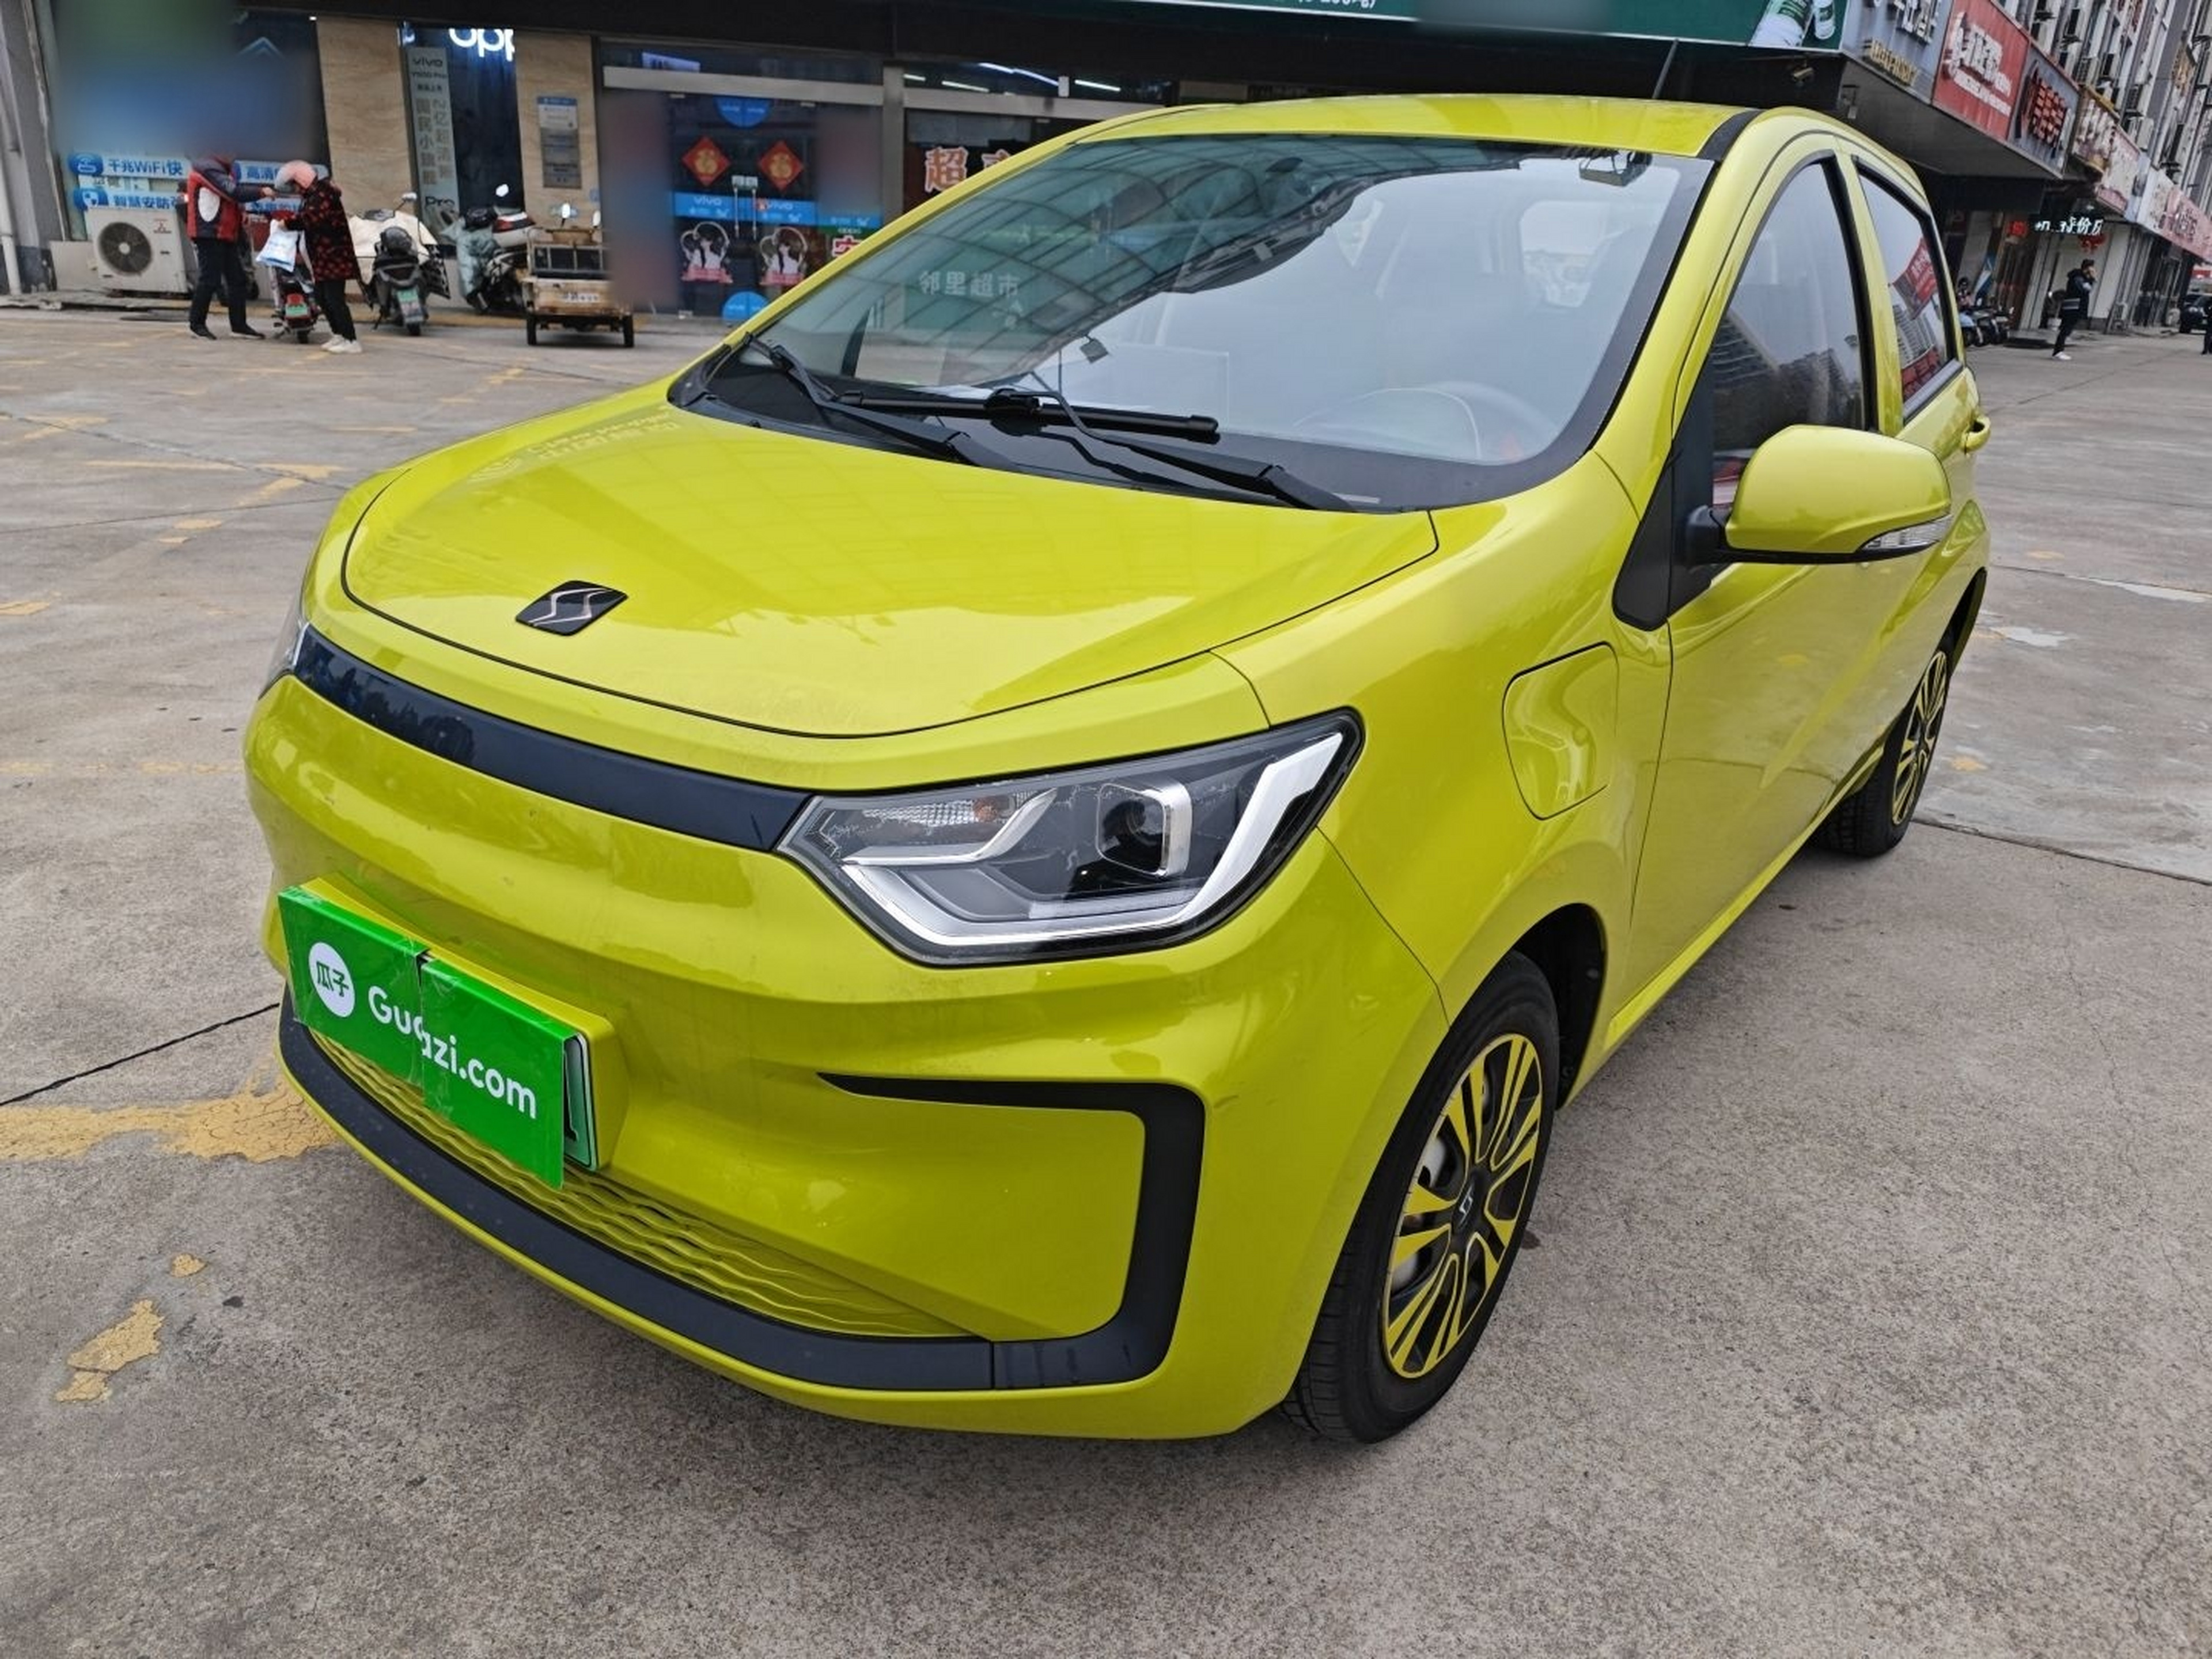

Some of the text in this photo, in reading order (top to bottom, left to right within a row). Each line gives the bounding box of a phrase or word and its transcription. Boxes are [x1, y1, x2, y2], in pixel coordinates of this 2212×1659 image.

[412, 58, 443, 67] vivo
[108, 158, 183, 175] 千兆WiFi快
[693, 196, 722, 206] vivo
[767, 201, 793, 210] vivo
[920, 271, 1019, 297] 邻里超市
[316, 961, 350, 997] 瓜子
